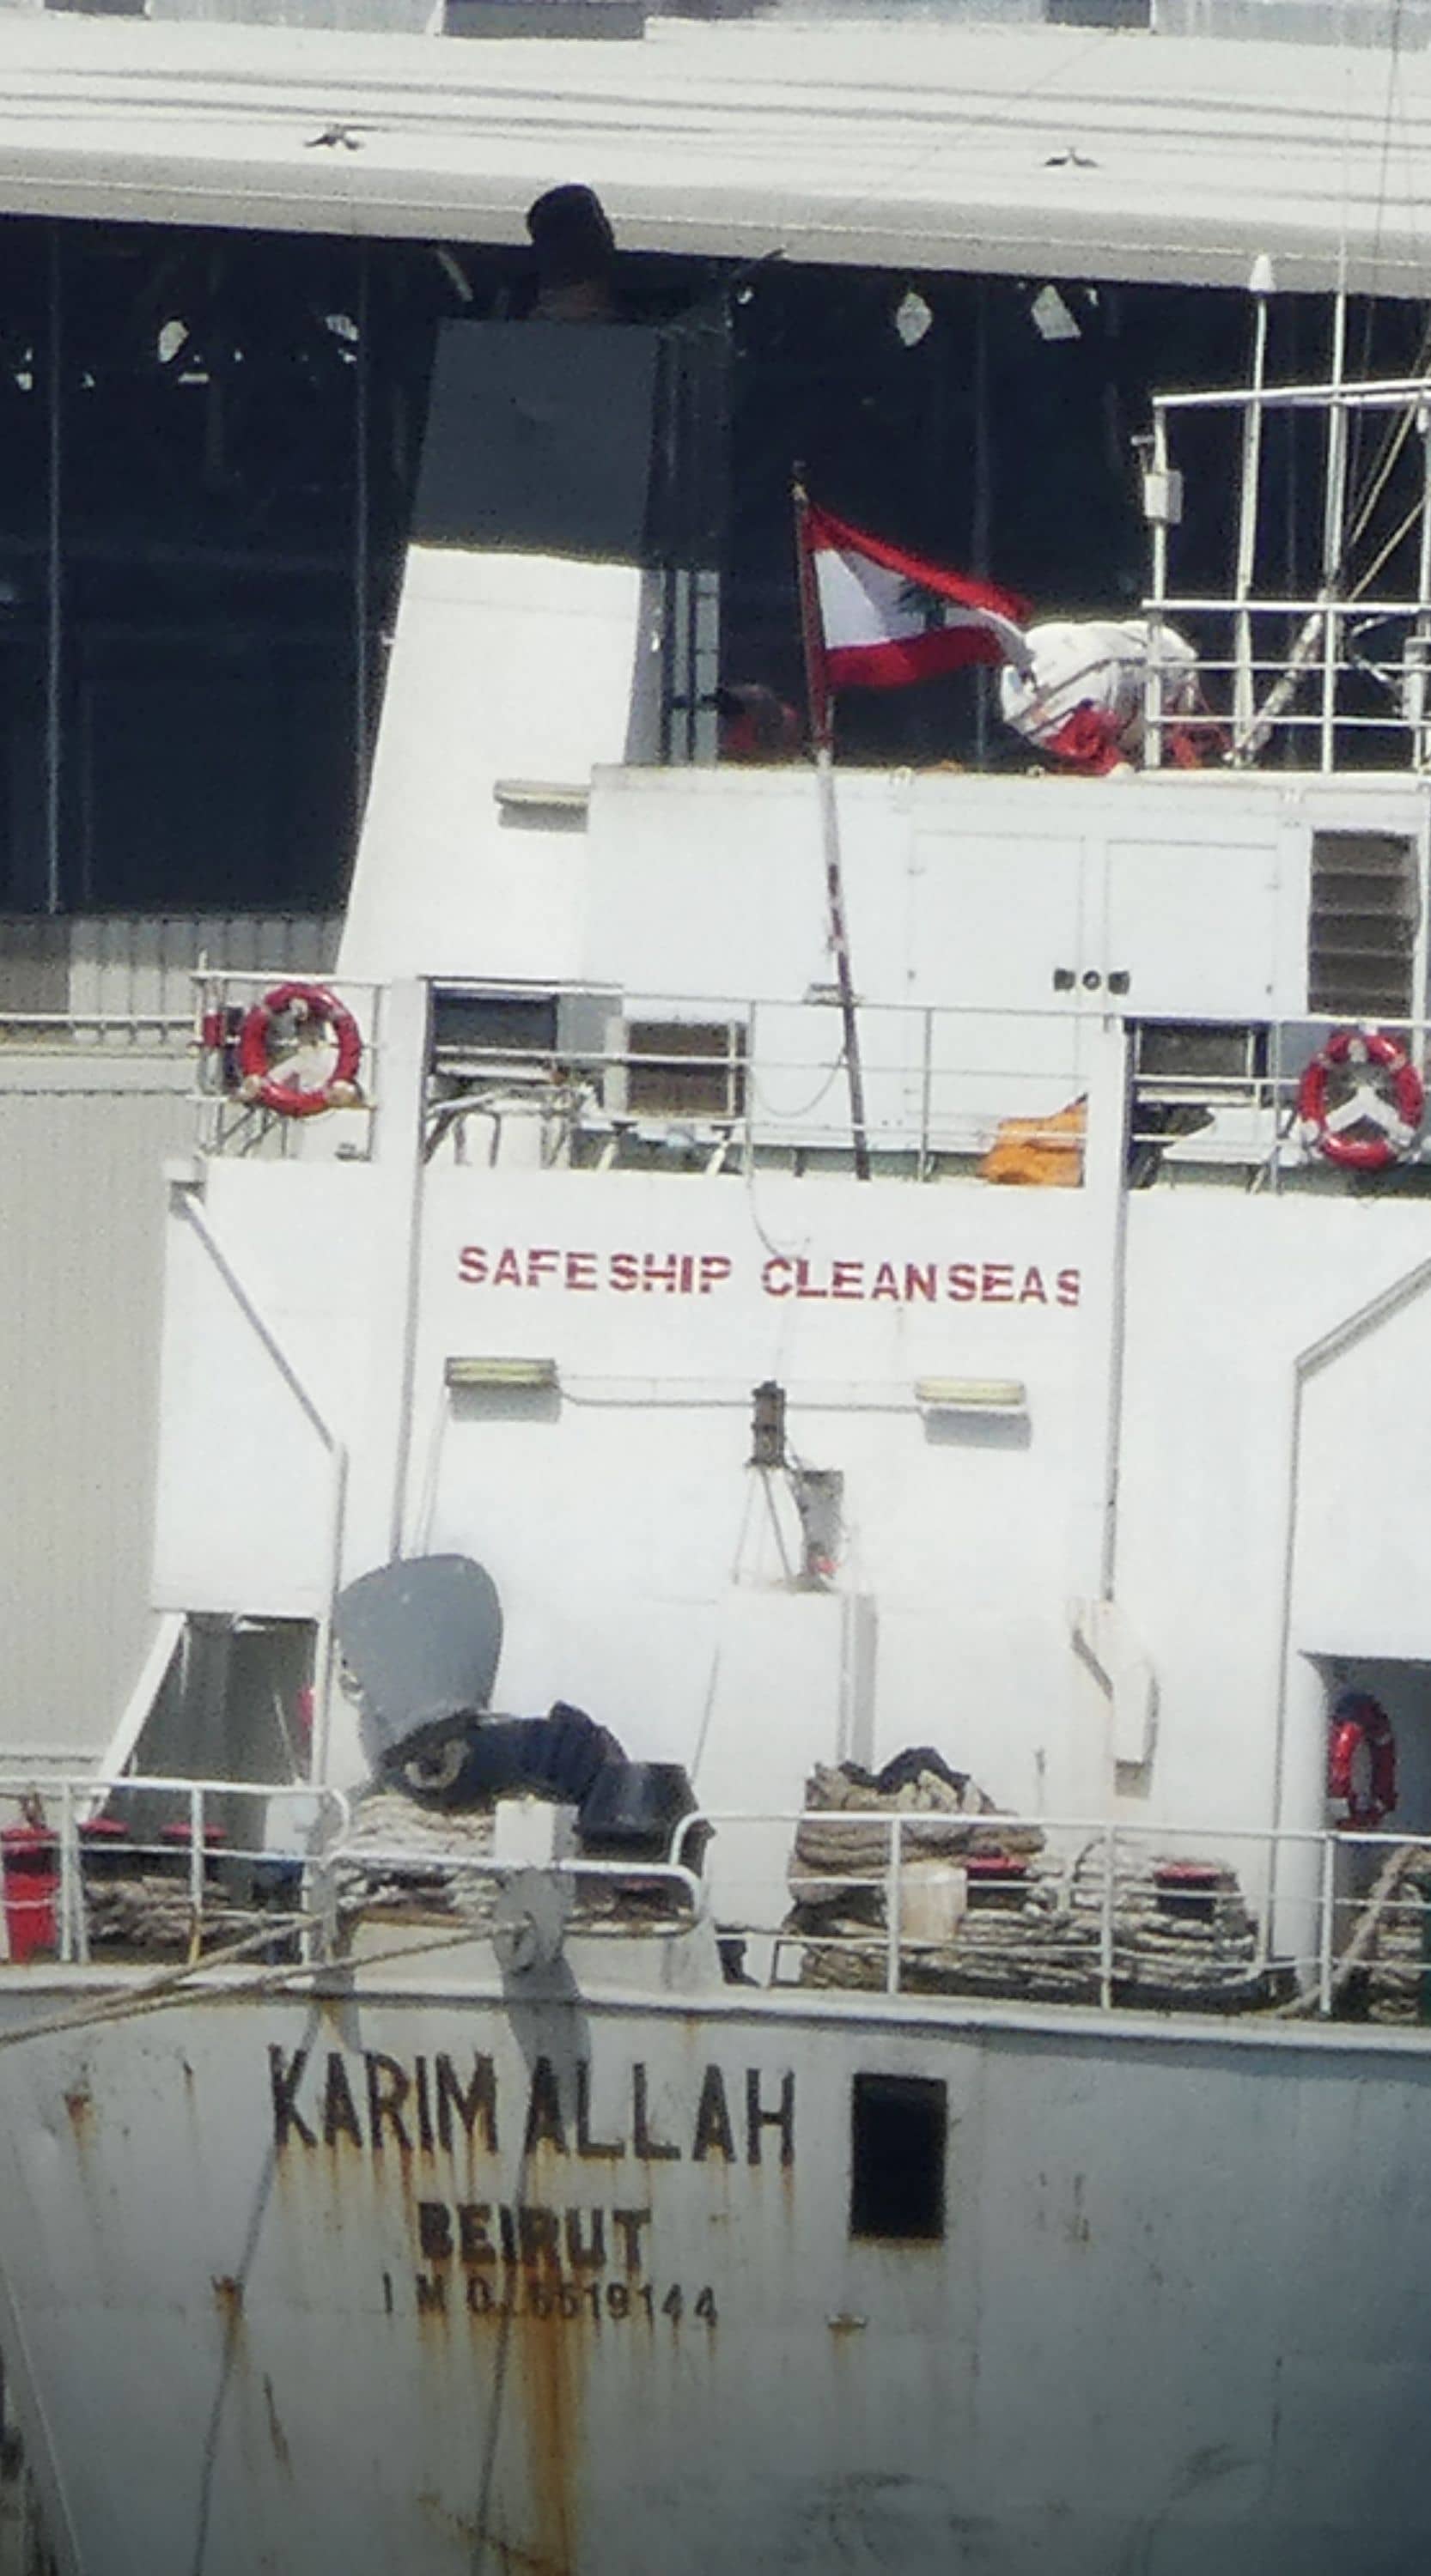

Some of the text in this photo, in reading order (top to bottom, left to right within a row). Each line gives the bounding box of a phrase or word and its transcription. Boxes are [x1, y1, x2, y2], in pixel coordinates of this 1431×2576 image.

[268, 2044, 796, 2166] KARIM ALLAH
[417, 2200, 651, 2274] BEIRUT
